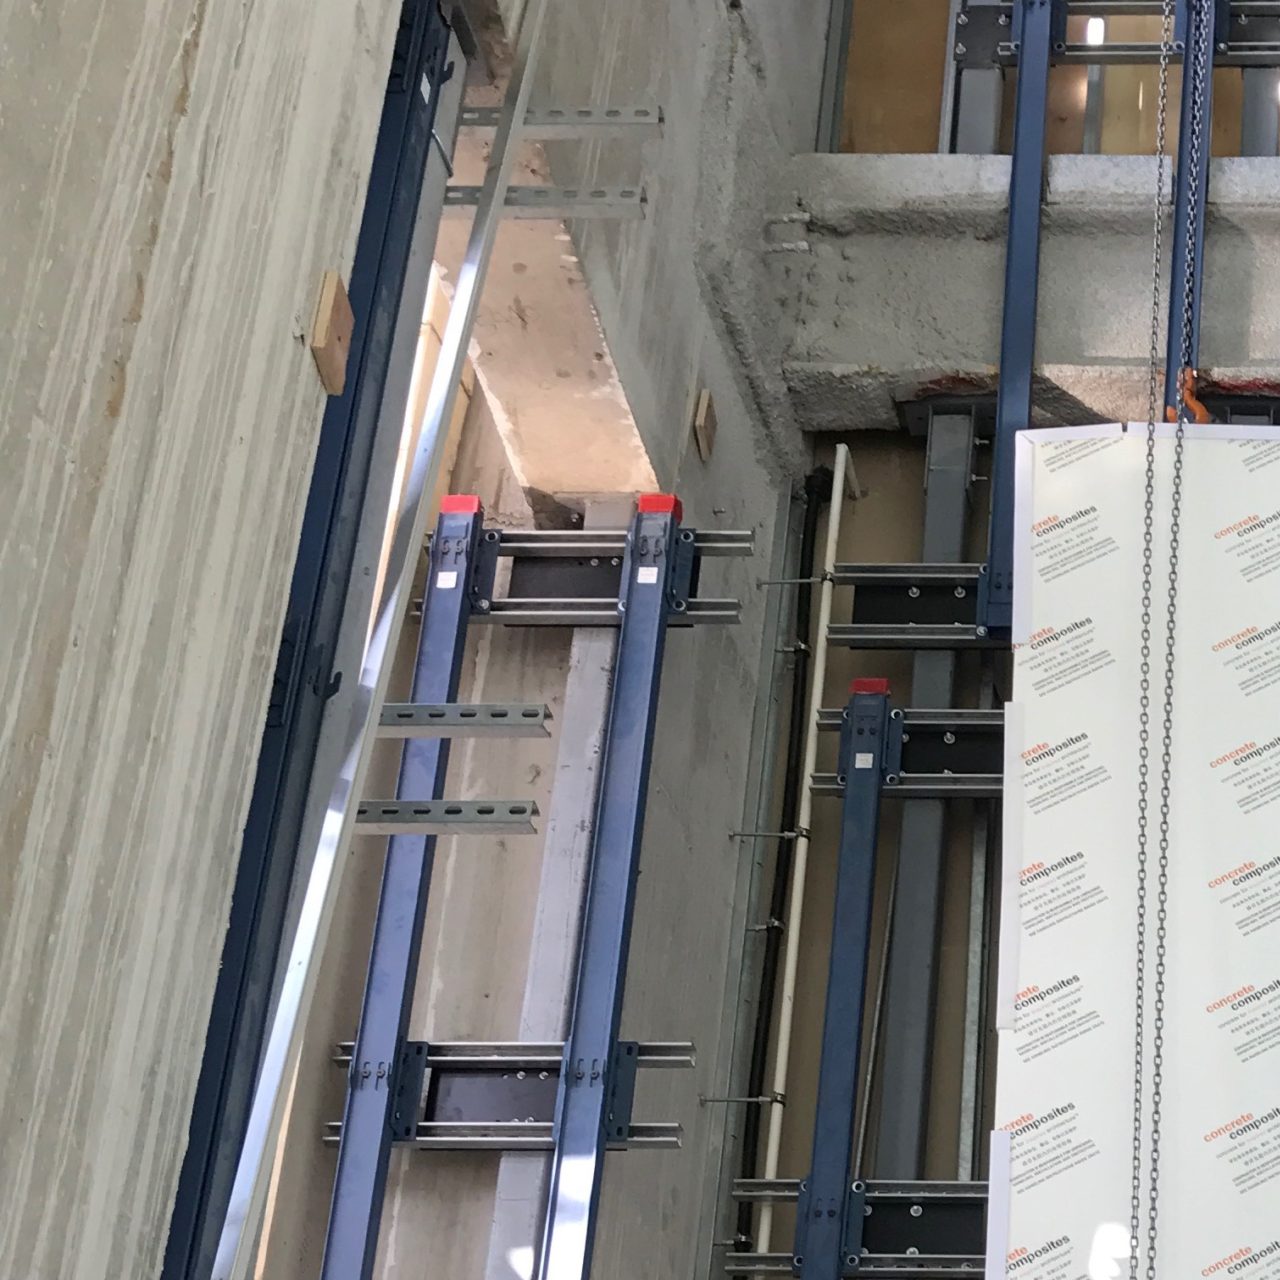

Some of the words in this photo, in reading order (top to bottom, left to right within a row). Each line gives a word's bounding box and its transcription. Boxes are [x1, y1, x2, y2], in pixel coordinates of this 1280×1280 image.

[1036, 506, 1098, 538] composites
[1214, 514, 1259, 540] concrete
[1030, 616, 1092, 650] composites
[1212, 625, 1258, 652] concrete
[1025, 732, 1088, 767] composites
[1209, 741, 1256, 768] concrete
[1020, 851, 1084, 886] composites
[1208, 860, 1256, 889] concrete
[1014, 974, 1080, 1011] composites
[1206, 985, 1255, 1013] concrete
[1204, 1113, 1254, 1142] concrete
[1202, 1246, 1252, 1277] concrete
